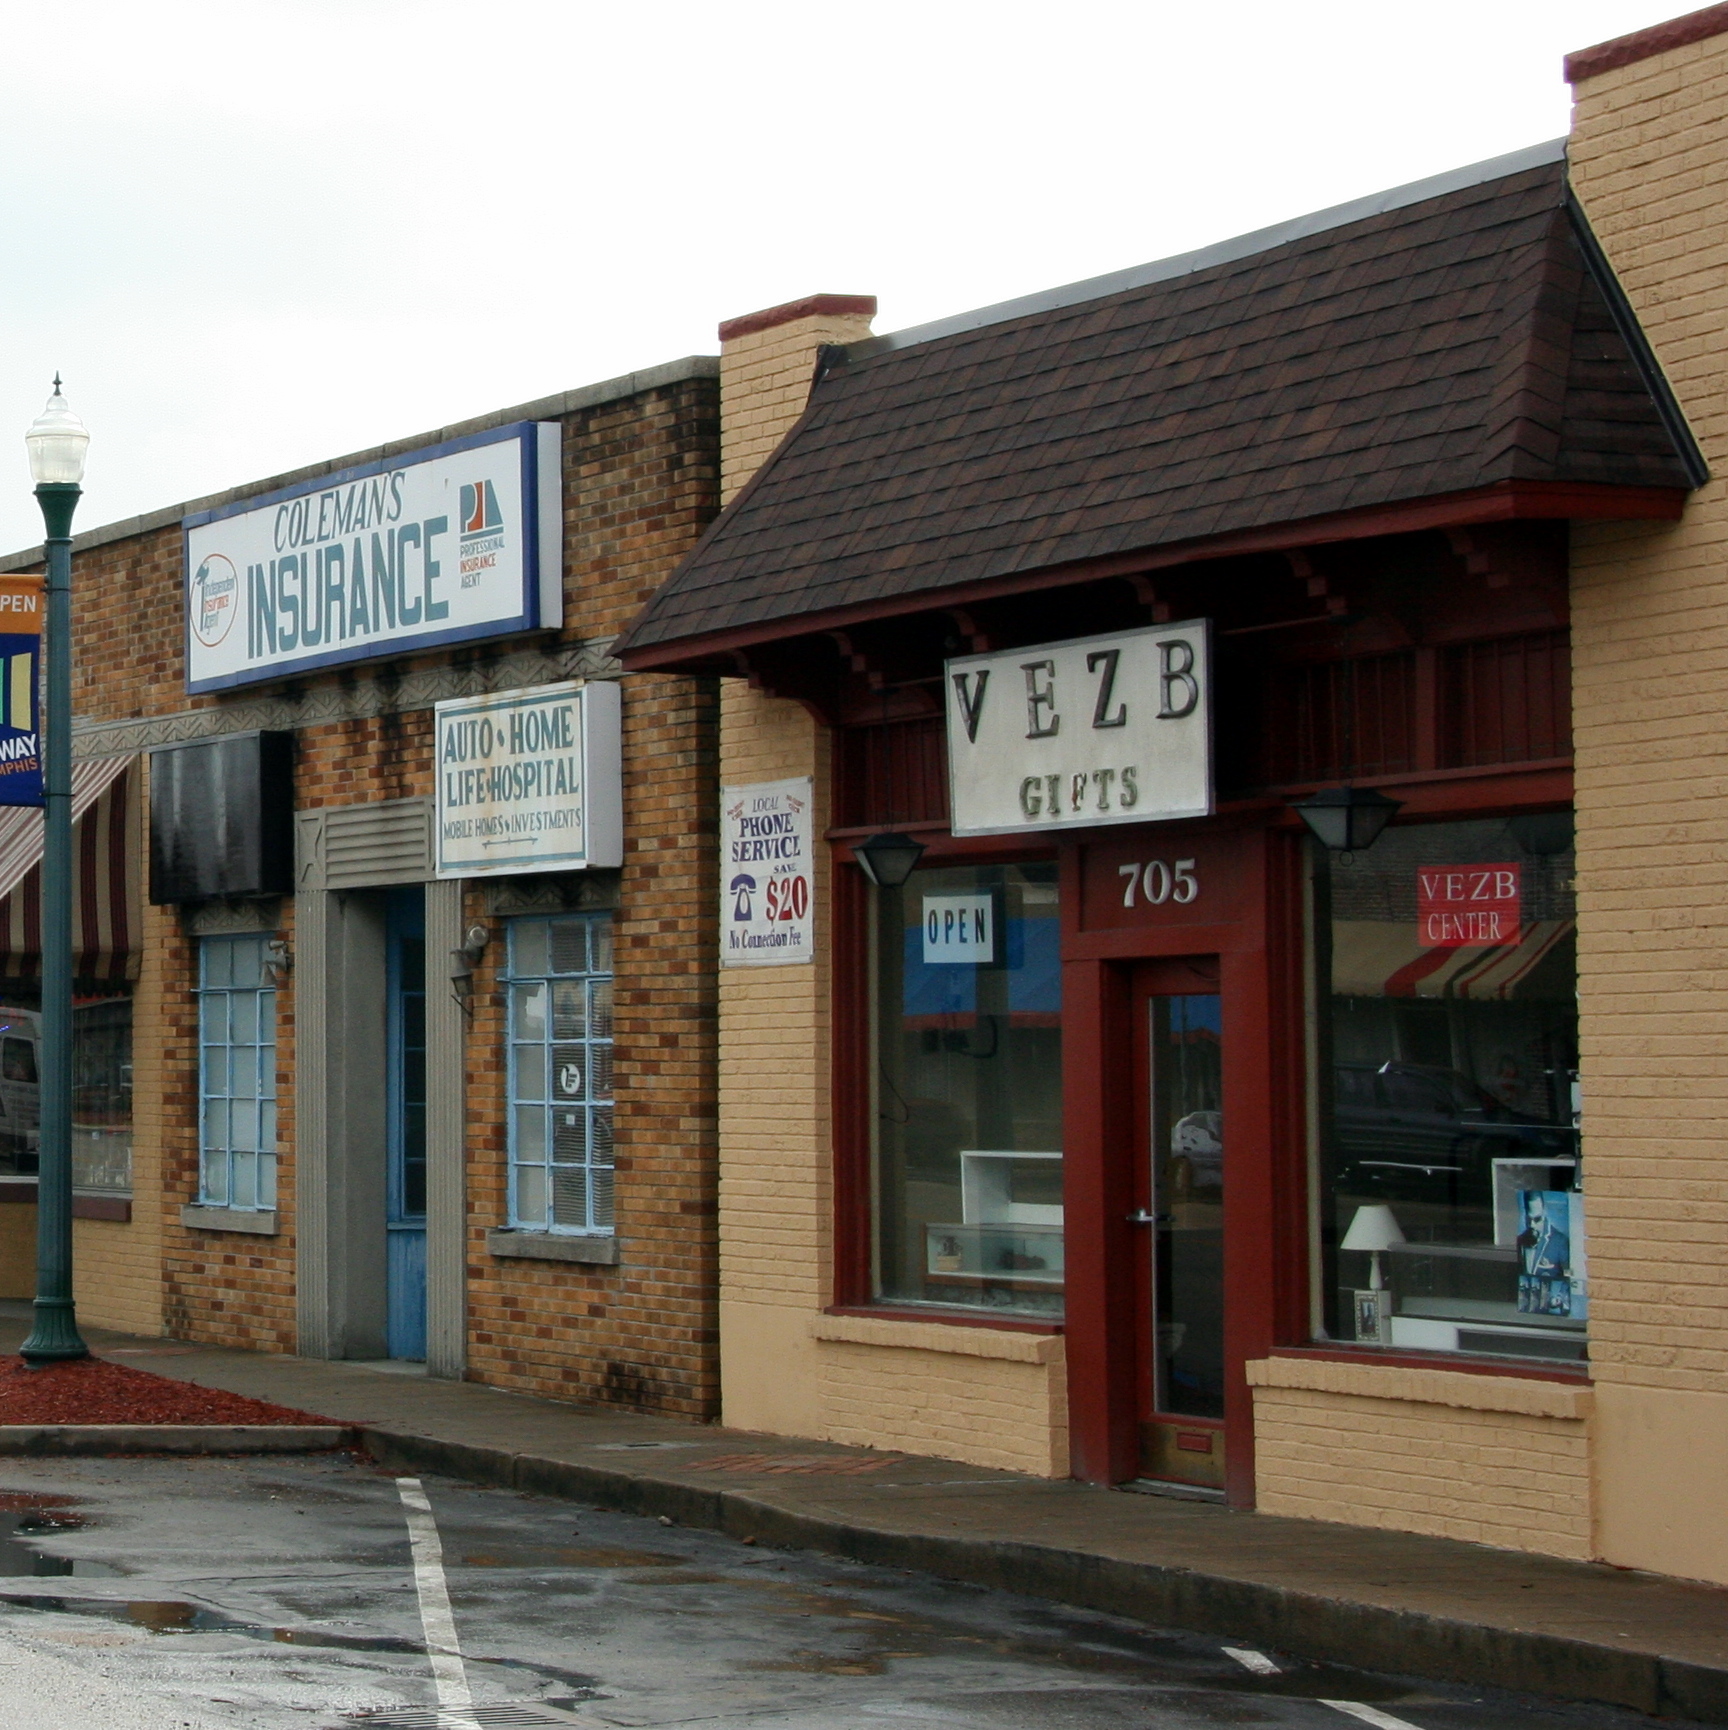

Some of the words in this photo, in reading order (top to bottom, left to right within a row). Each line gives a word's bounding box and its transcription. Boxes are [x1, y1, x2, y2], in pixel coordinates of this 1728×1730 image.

[459, 535, 505, 559] PROFESSIONAL
[460, 553, 497, 574] INSURANCE
[247, 515, 449, 660] INSURANCE
[460, 572, 481, 589] AGENT
[952, 638, 1199, 744] VEZB
[443, 717, 493, 764] AUTO
[509, 705, 574, 755] HOME
[446, 768, 486, 807] LIFE
[490, 756, 579, 802] HOSPITAL
[1021, 766, 1138, 815] GIFTS
[752, 796, 779, 813] LOCAL
[444, 819, 473, 840] MOBILE
[475, 814, 504, 837] HOMES
[511, 808, 581, 833] INVESTMENTS
[739, 812, 794, 838] PHONE
[1119, 859, 1198, 908] 705
[1421, 871, 1516, 901] VEZB
[766, 874, 808, 926] $20
[729, 929, 740, 949] No
[742, 928, 787, 949] Connection
[789, 926, 801, 946] Fee
[927, 908, 985, 944] OPEN
[1427, 911, 1501, 940] CENTER
